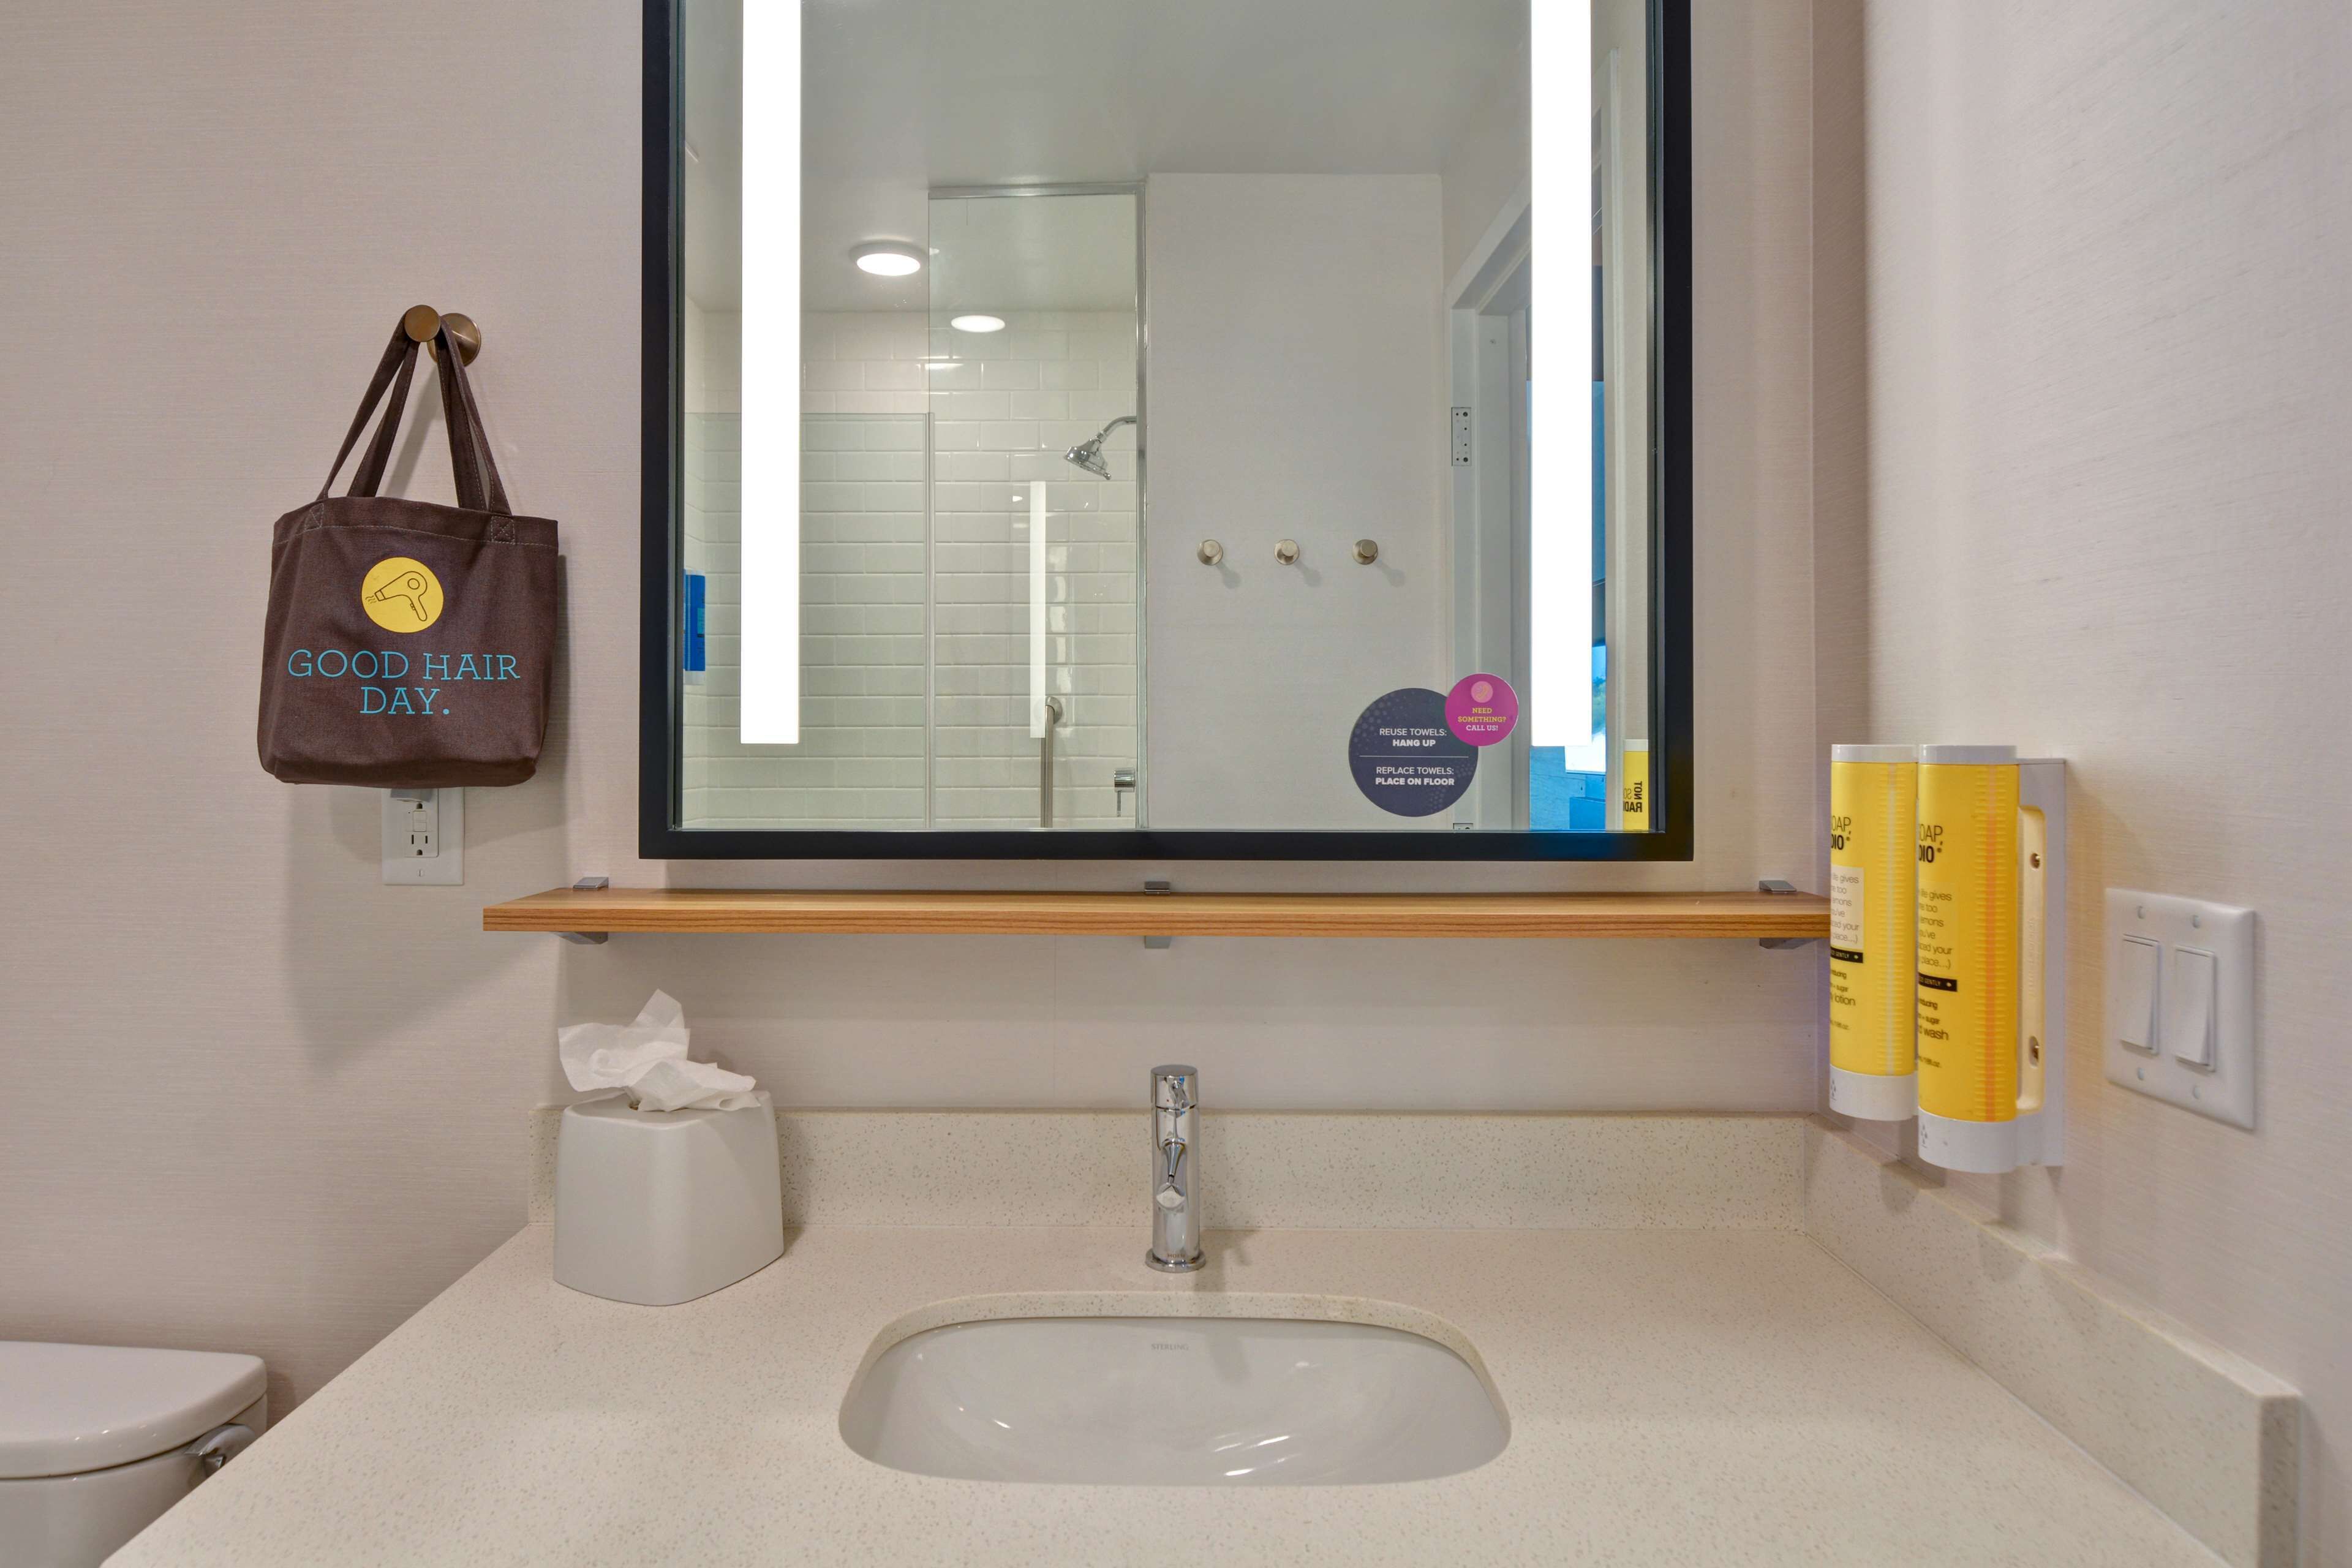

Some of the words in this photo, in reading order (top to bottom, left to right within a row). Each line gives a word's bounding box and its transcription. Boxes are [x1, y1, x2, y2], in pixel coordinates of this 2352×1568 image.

[288, 649, 409, 679] GOOD
[423, 652, 521, 680] HAIR
[360, 686, 450, 715] DAY.
[1832, 815, 1852, 834] OAP,
[1920, 824, 1943, 845] OAP,
[1920, 916, 1944, 927] emons
